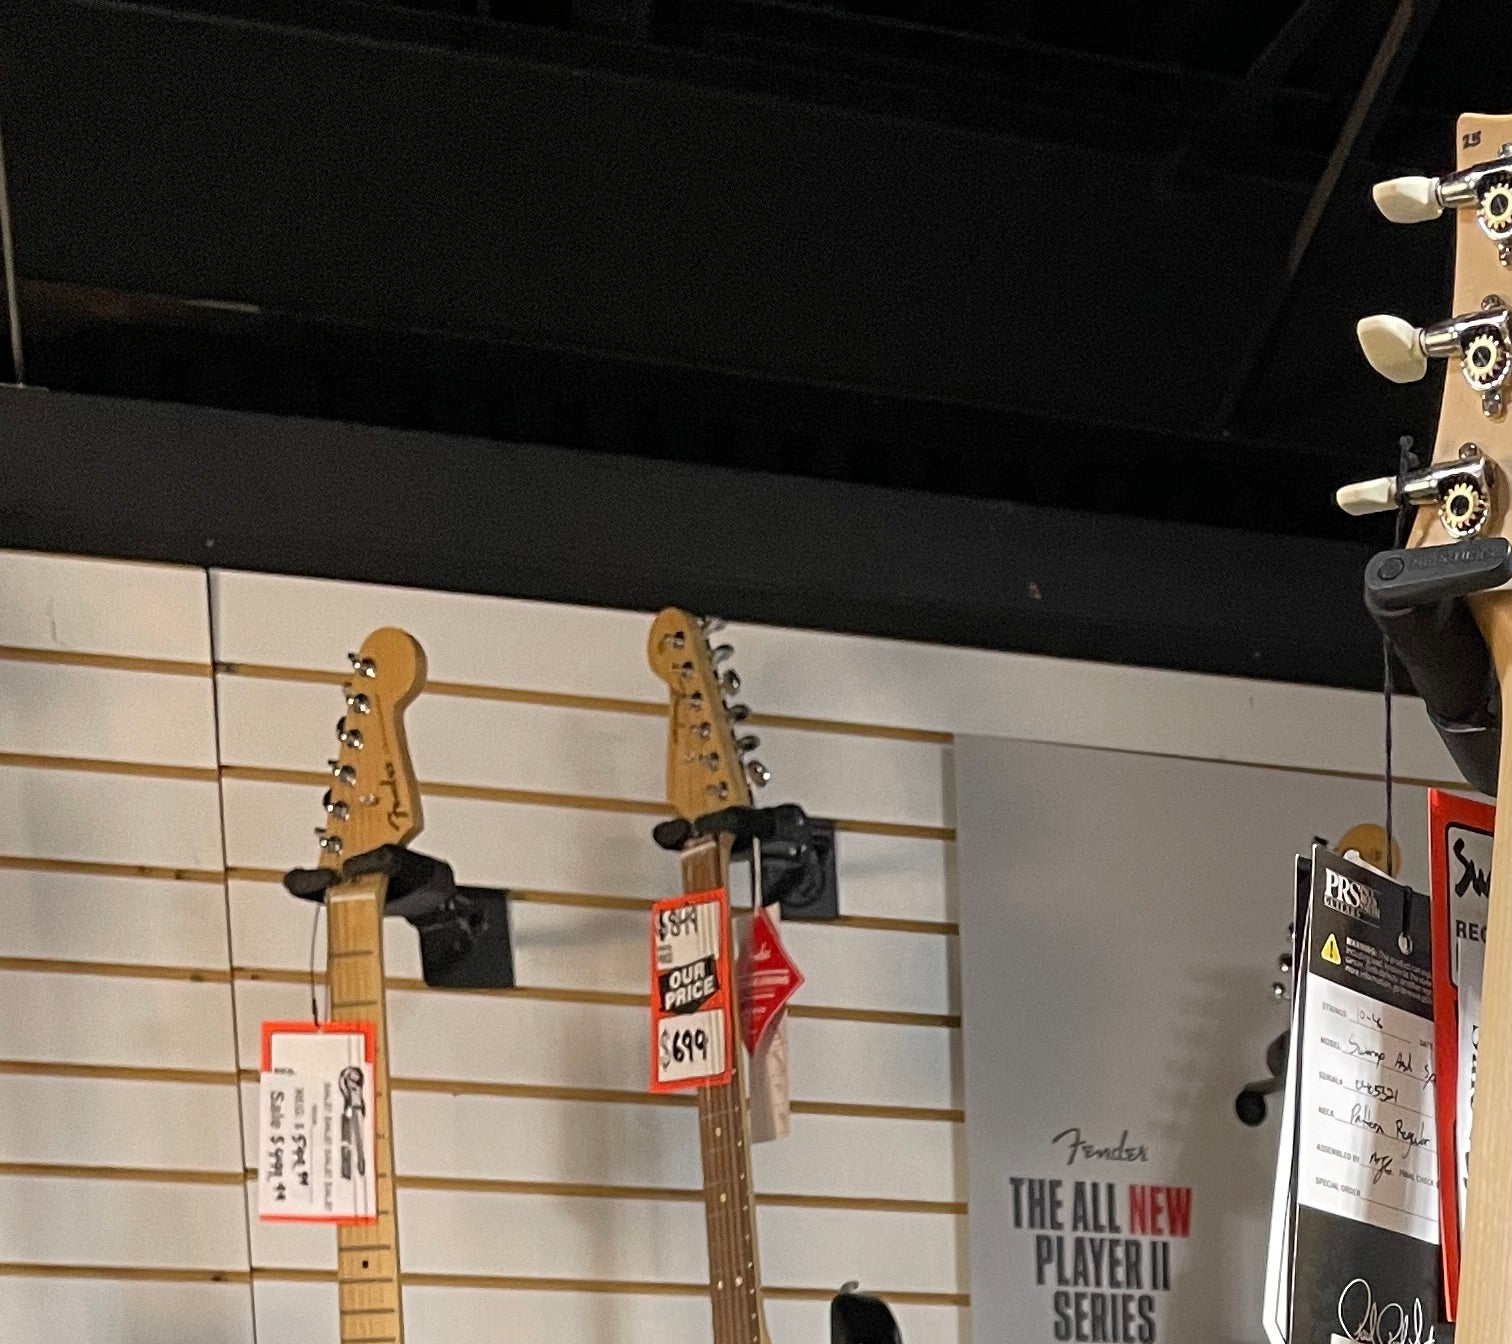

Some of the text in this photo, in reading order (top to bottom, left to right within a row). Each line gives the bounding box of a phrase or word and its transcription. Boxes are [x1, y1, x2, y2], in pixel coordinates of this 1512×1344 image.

[1461, 130, 1482, 149] 25
[1325, 866, 1361, 909] PRS
[664, 974, 717, 1011] PRICE
[669, 961, 706, 990] OUR
[660, 1027, 709, 1072] $699
[1051, 1127, 1149, 1166] Fender
[1009, 1176, 1192, 1238] THE ALL NEW
[1035, 1234, 1171, 1291] PLAYER II
[1053, 1290, 1156, 1344] SERIES
